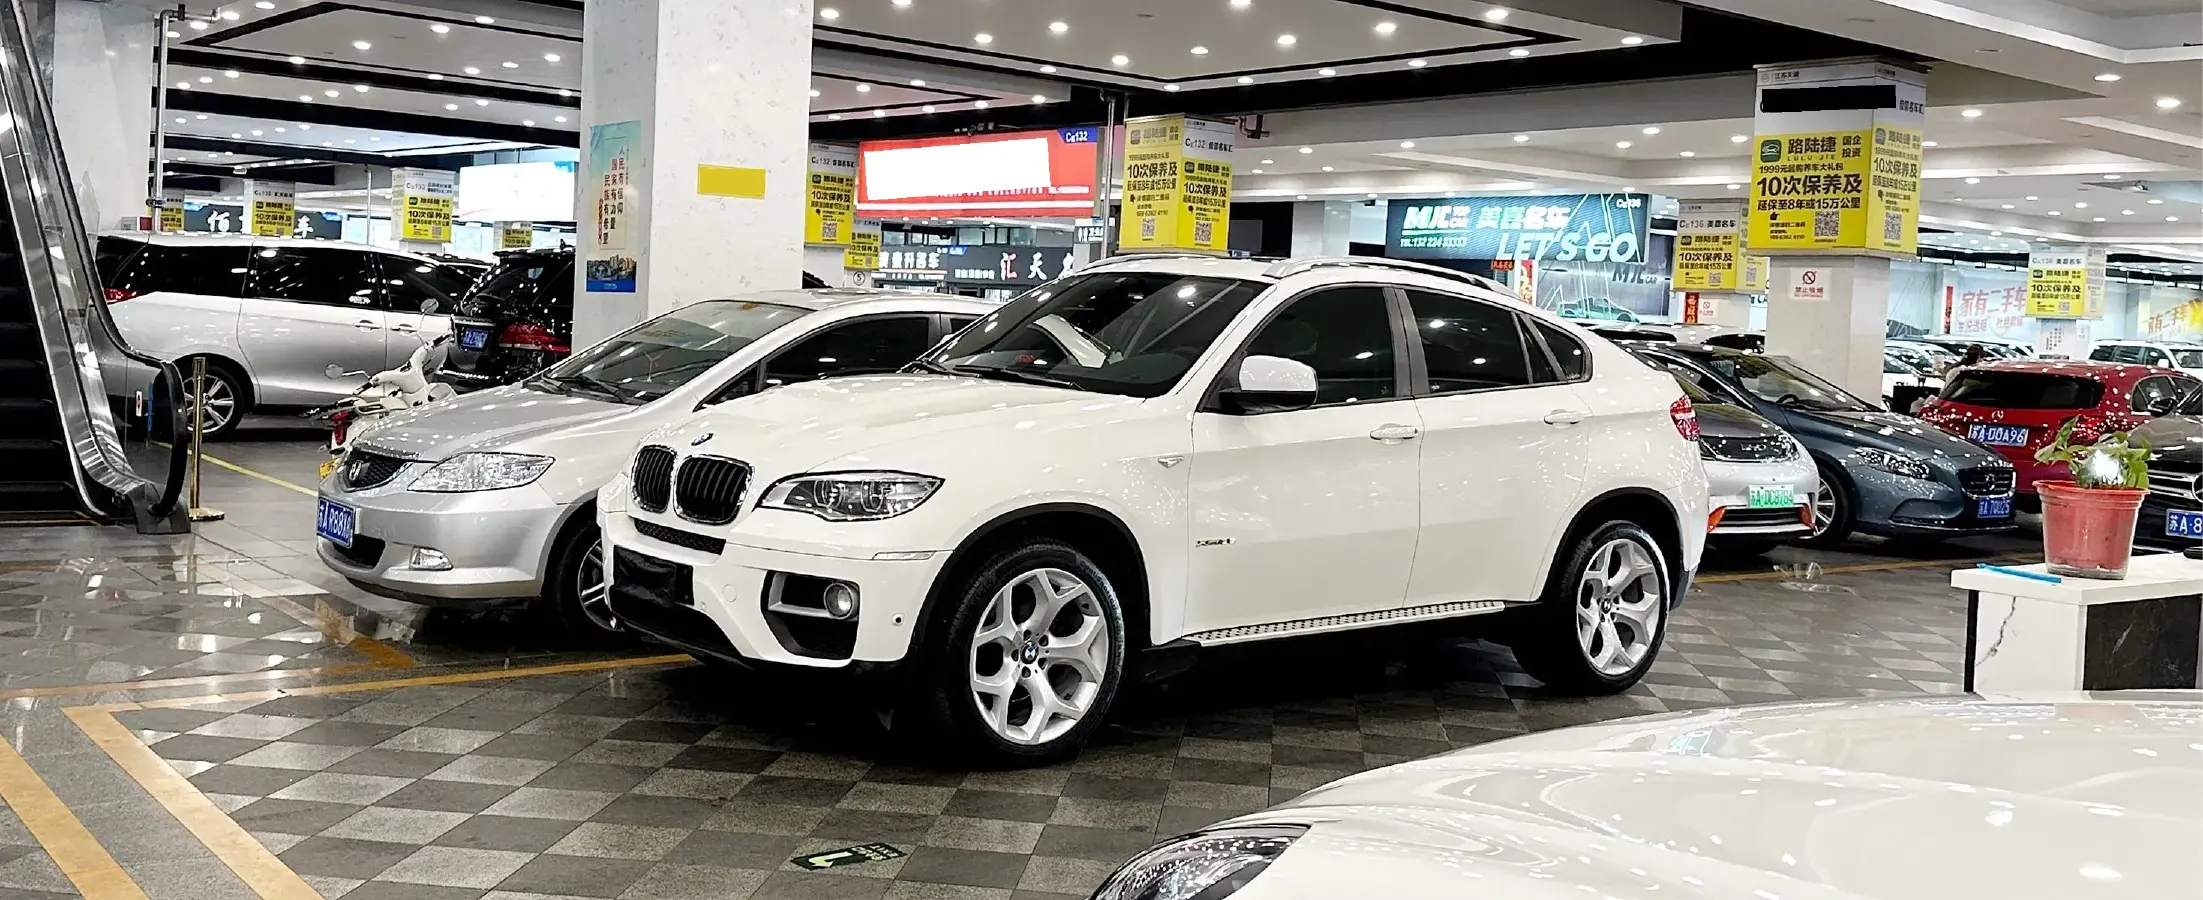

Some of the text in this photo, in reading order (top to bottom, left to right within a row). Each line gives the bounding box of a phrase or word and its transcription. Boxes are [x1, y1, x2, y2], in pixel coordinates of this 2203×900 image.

[1788, 137, 1837, 155] 路陆捷
[1842, 135, 1862, 146] 国企
[1841, 147, 1862, 159] 投资
[1127, 161, 1178, 179] 10次保养及
[1873, 156, 1918, 179] 10次保养及
[616, 144, 625, 215] 人民有信仰
[1757, 173, 1863, 197] 10次保养及
[811, 190, 851, 203] 10次保养及
[1183, 181, 1227, 198] 10次保养及
[1757, 196, 1861, 211] 延保至8年或15万公里
[1495, 231, 1637, 263] LET'S GO
[1679, 252, 1733, 263] 10次保养及
[2031, 283, 2082, 293] 10次保养及
[1960, 286, 2028, 316] 家有二手车
